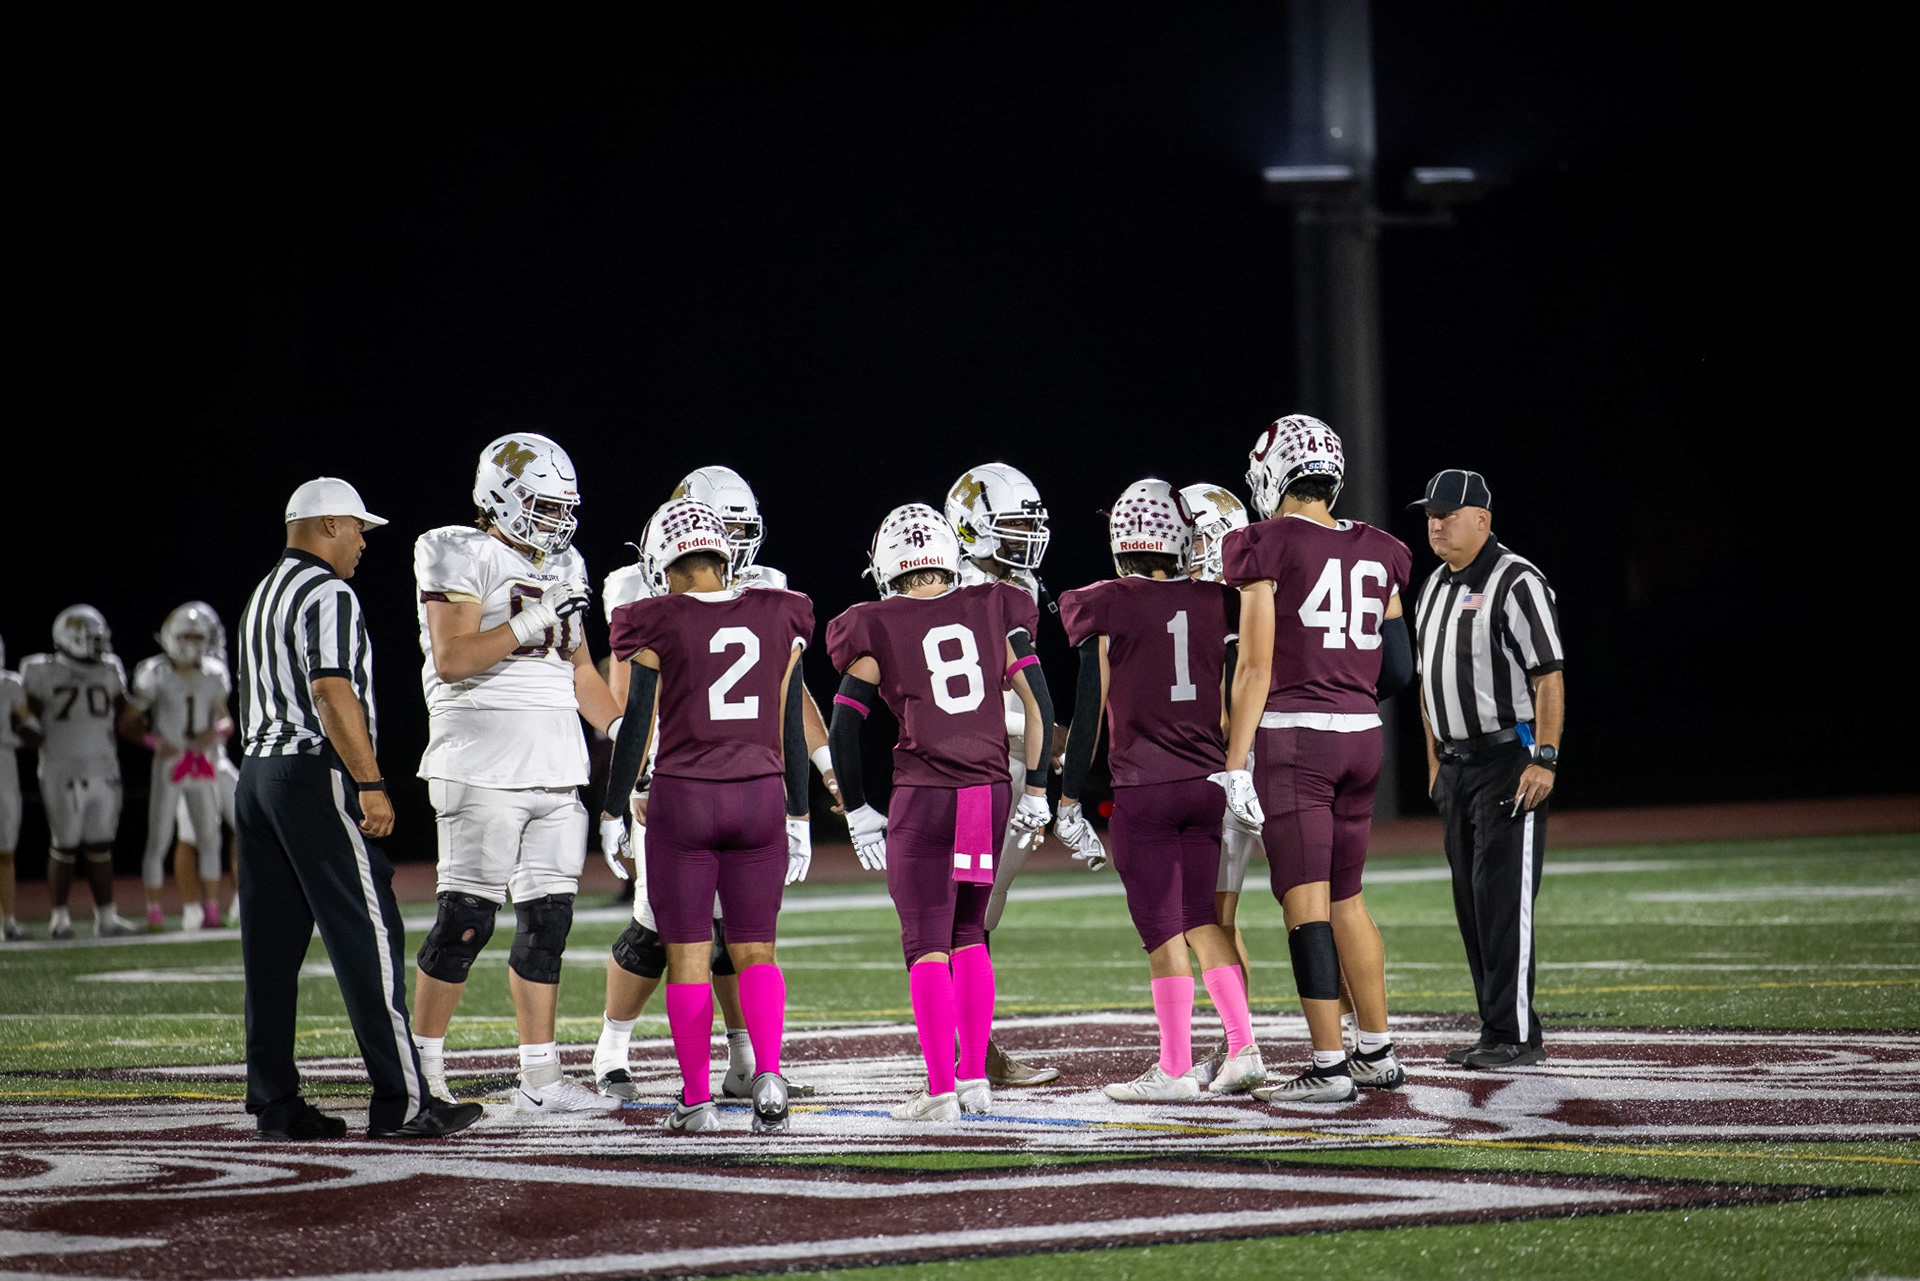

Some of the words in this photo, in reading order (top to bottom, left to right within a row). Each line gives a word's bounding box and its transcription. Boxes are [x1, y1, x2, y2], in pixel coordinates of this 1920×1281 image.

[491, 440, 538, 479] M
[688, 514, 703, 530] 2
[677, 537, 722, 552] Riddell
[900, 556, 944, 570] Riddell
[1120, 541, 1163, 551] Riddell
[1298, 558, 1388, 650] 46
[708, 626, 761, 721] 2
[922, 623, 986, 715] 8
[1167, 610, 1197, 702] 1
[54, 685, 111, 721] 70
[184, 695, 197, 740] 1
